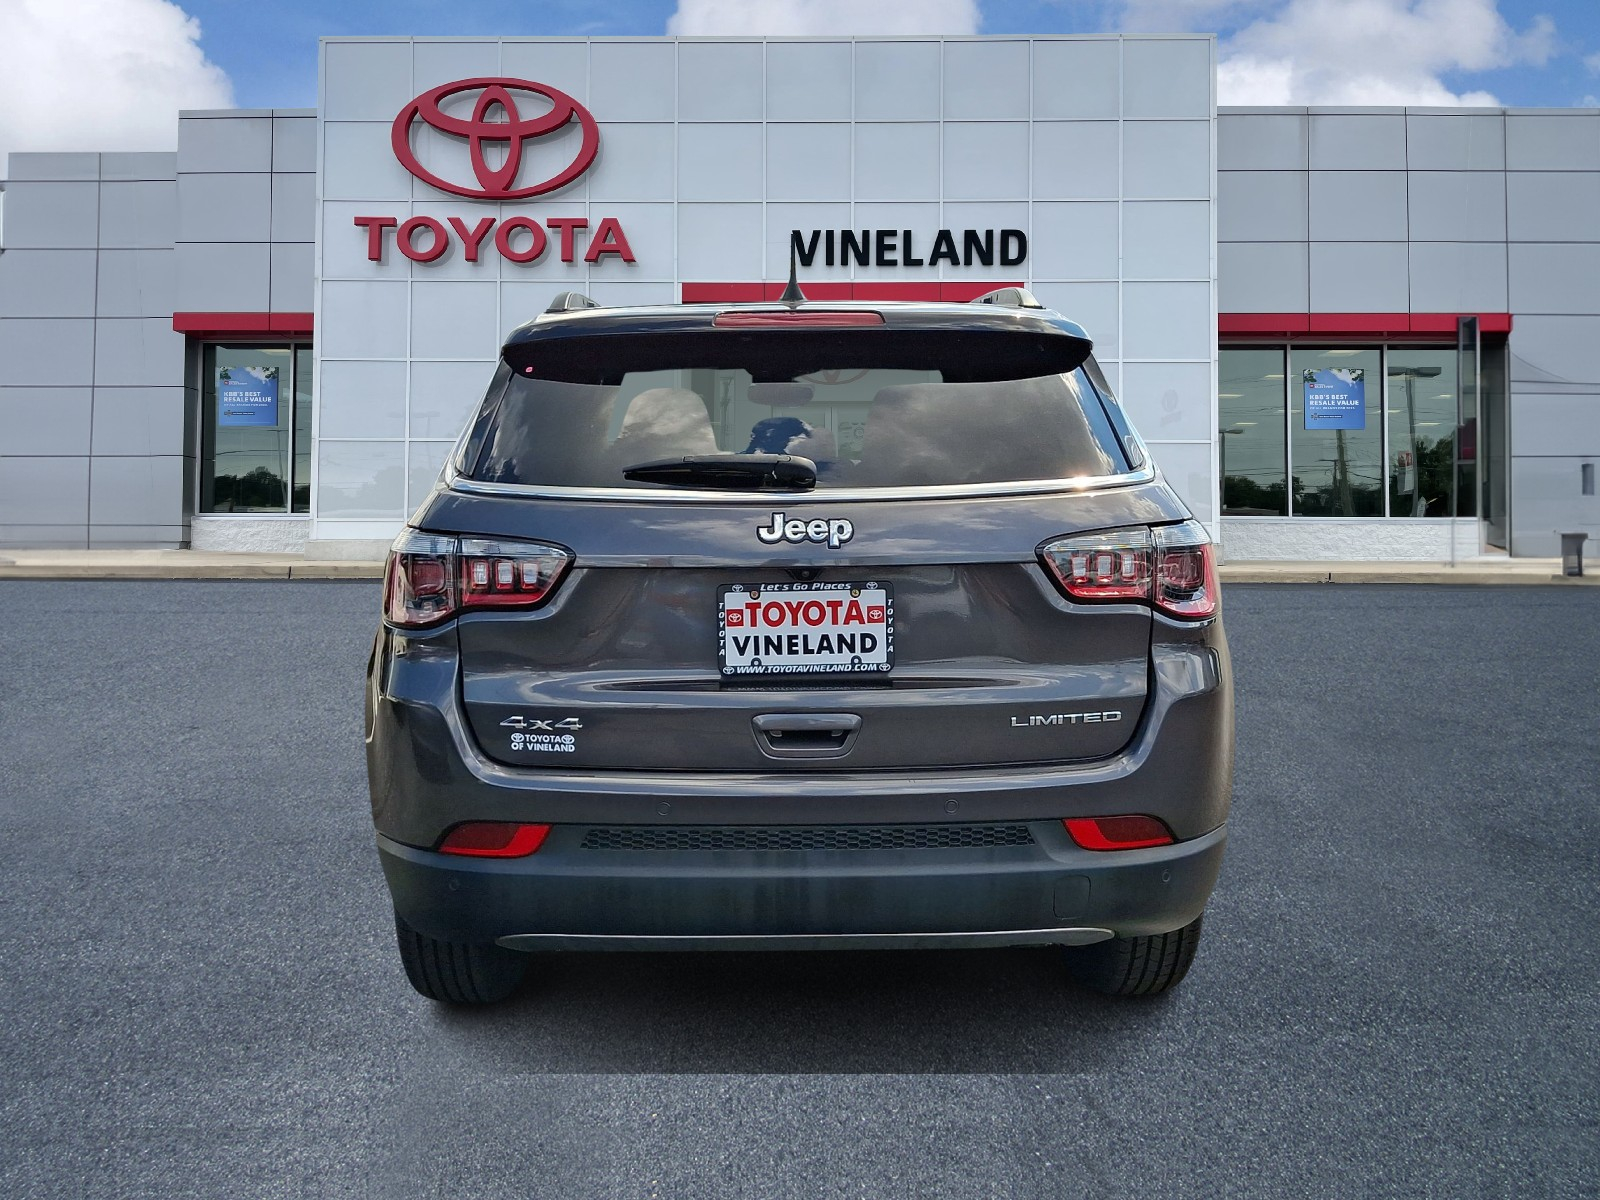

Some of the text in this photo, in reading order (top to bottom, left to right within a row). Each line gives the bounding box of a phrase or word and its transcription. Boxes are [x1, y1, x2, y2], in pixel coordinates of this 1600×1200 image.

[354, 216, 637, 263] TOYOTA
[793, 229, 1028, 266] VINELAND
[757, 512, 854, 548] Jeep
[760, 582, 851, 591] Let's Go Places
[745, 599, 866, 627] TOYOTA
[718, 602, 726, 656] TOYOTA
[886, 598, 894, 653] TOYOTA
[732, 632, 878, 656] VINELAND
[736, 663, 878, 674] WWW.TOYOTAVINELAND.COM
[499, 715, 583, 730] 4x4
[1011, 710, 1122, 727] LIMITED
[511, 742, 575, 752] OF VINELAND
[524, 734, 561, 743] TOYOTA
